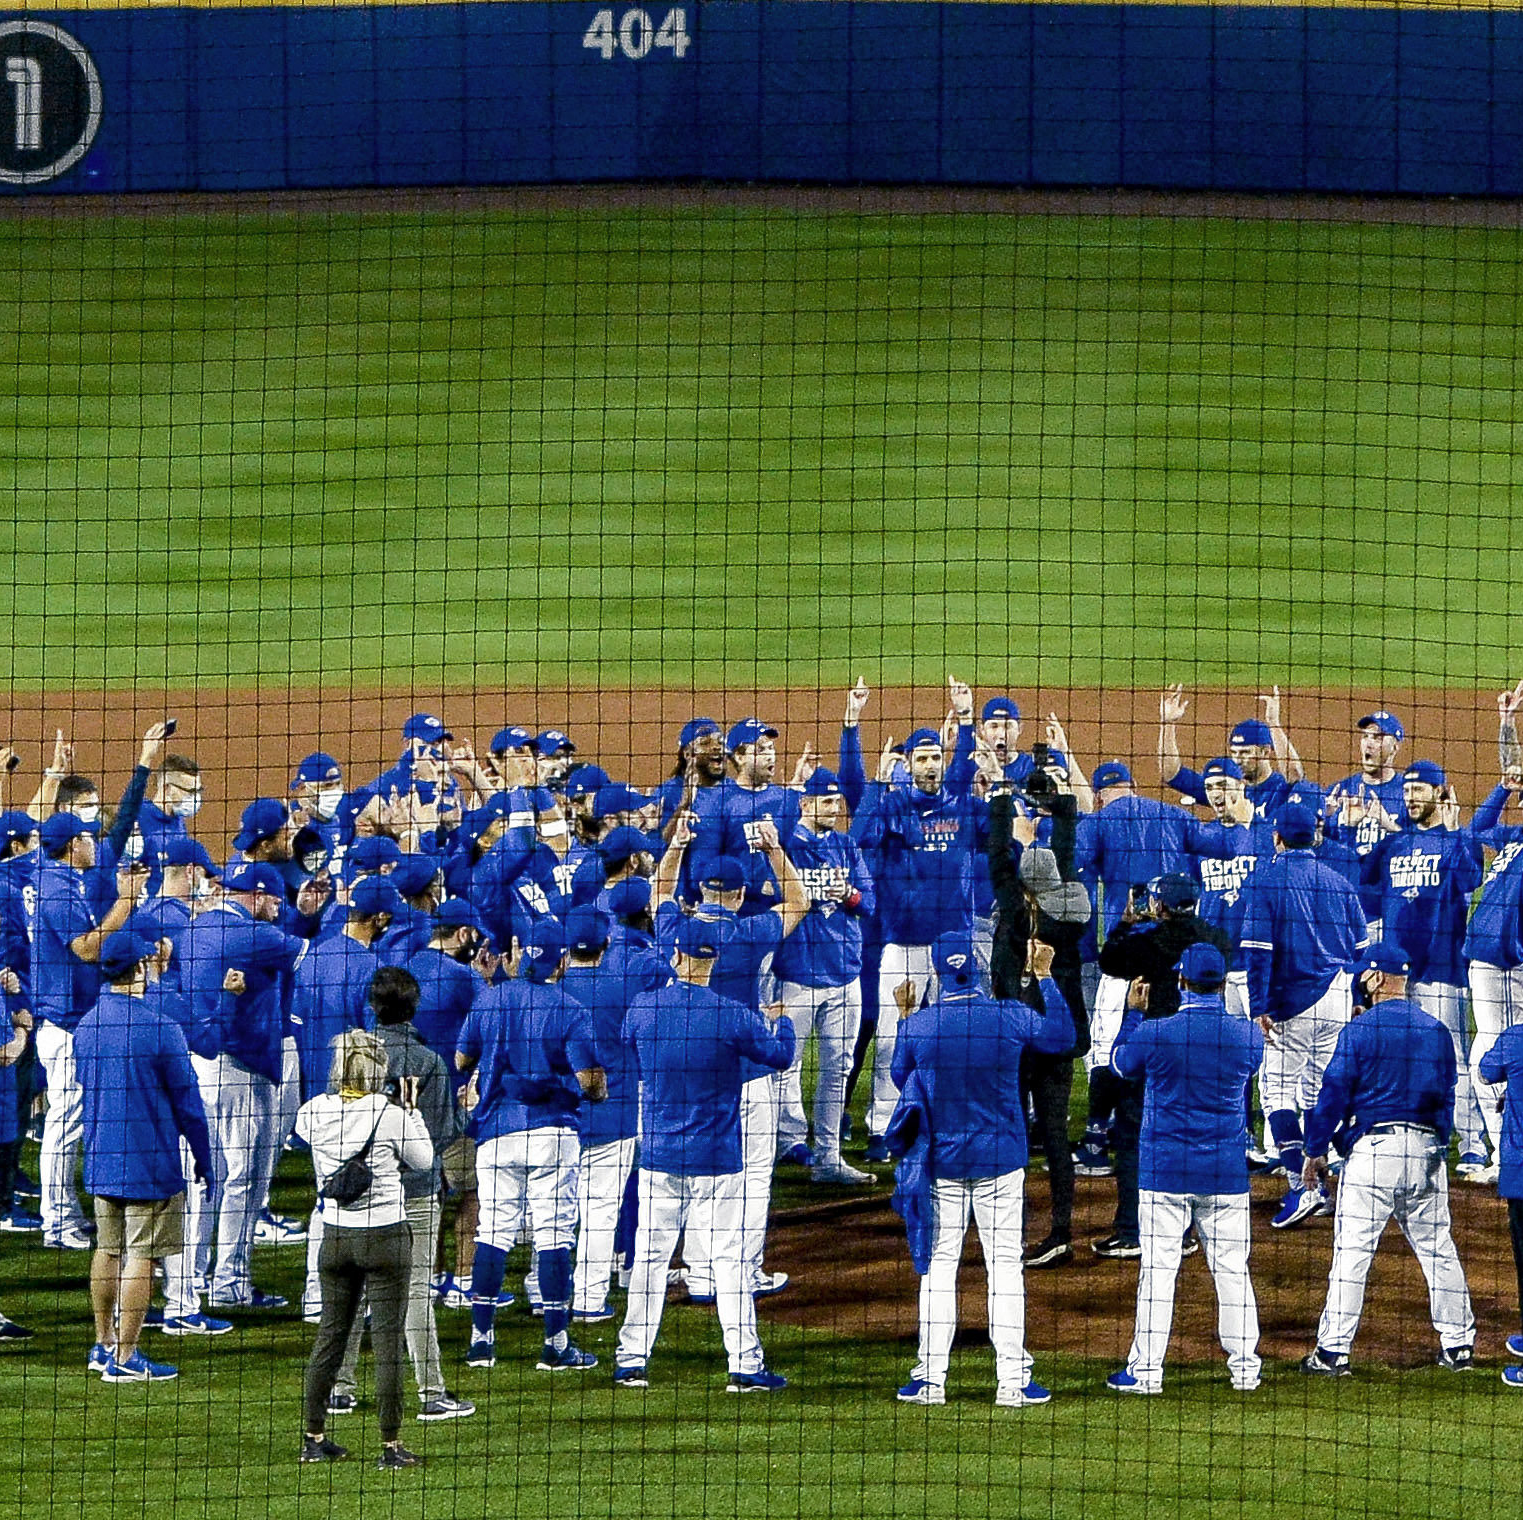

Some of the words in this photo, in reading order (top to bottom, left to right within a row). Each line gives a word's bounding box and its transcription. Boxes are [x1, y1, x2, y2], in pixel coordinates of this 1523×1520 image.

[582, 9, 691, 59] 404
[6, 57, 42, 151] 1
[1201, 856, 1257, 877] RESPECT
[1390, 854, 1442, 874] RESPECT
[1390, 871, 1440, 888] TORONTO
